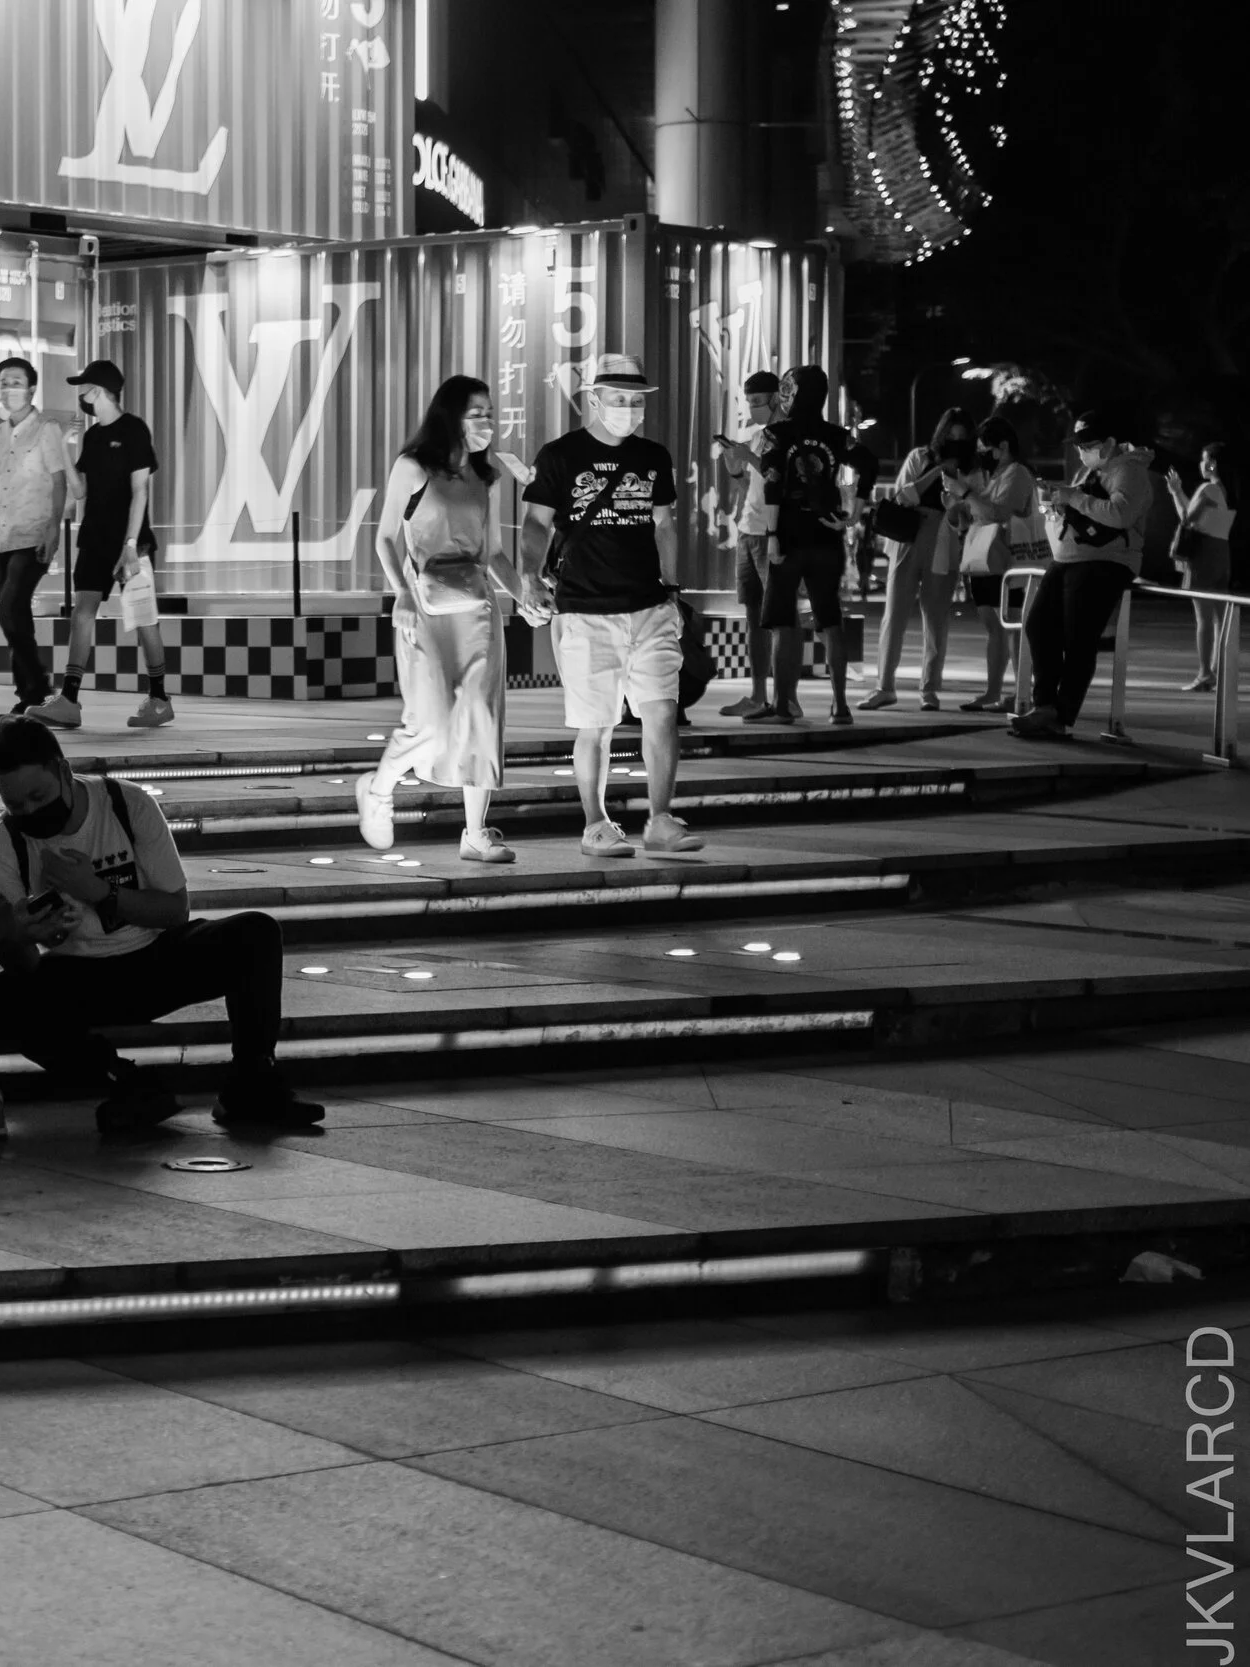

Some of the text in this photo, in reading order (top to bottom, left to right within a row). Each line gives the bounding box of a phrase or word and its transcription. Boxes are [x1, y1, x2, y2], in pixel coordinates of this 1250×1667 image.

[498, 271, 527, 440] 请勿打开
[593, 463, 619, 472] VINTA
